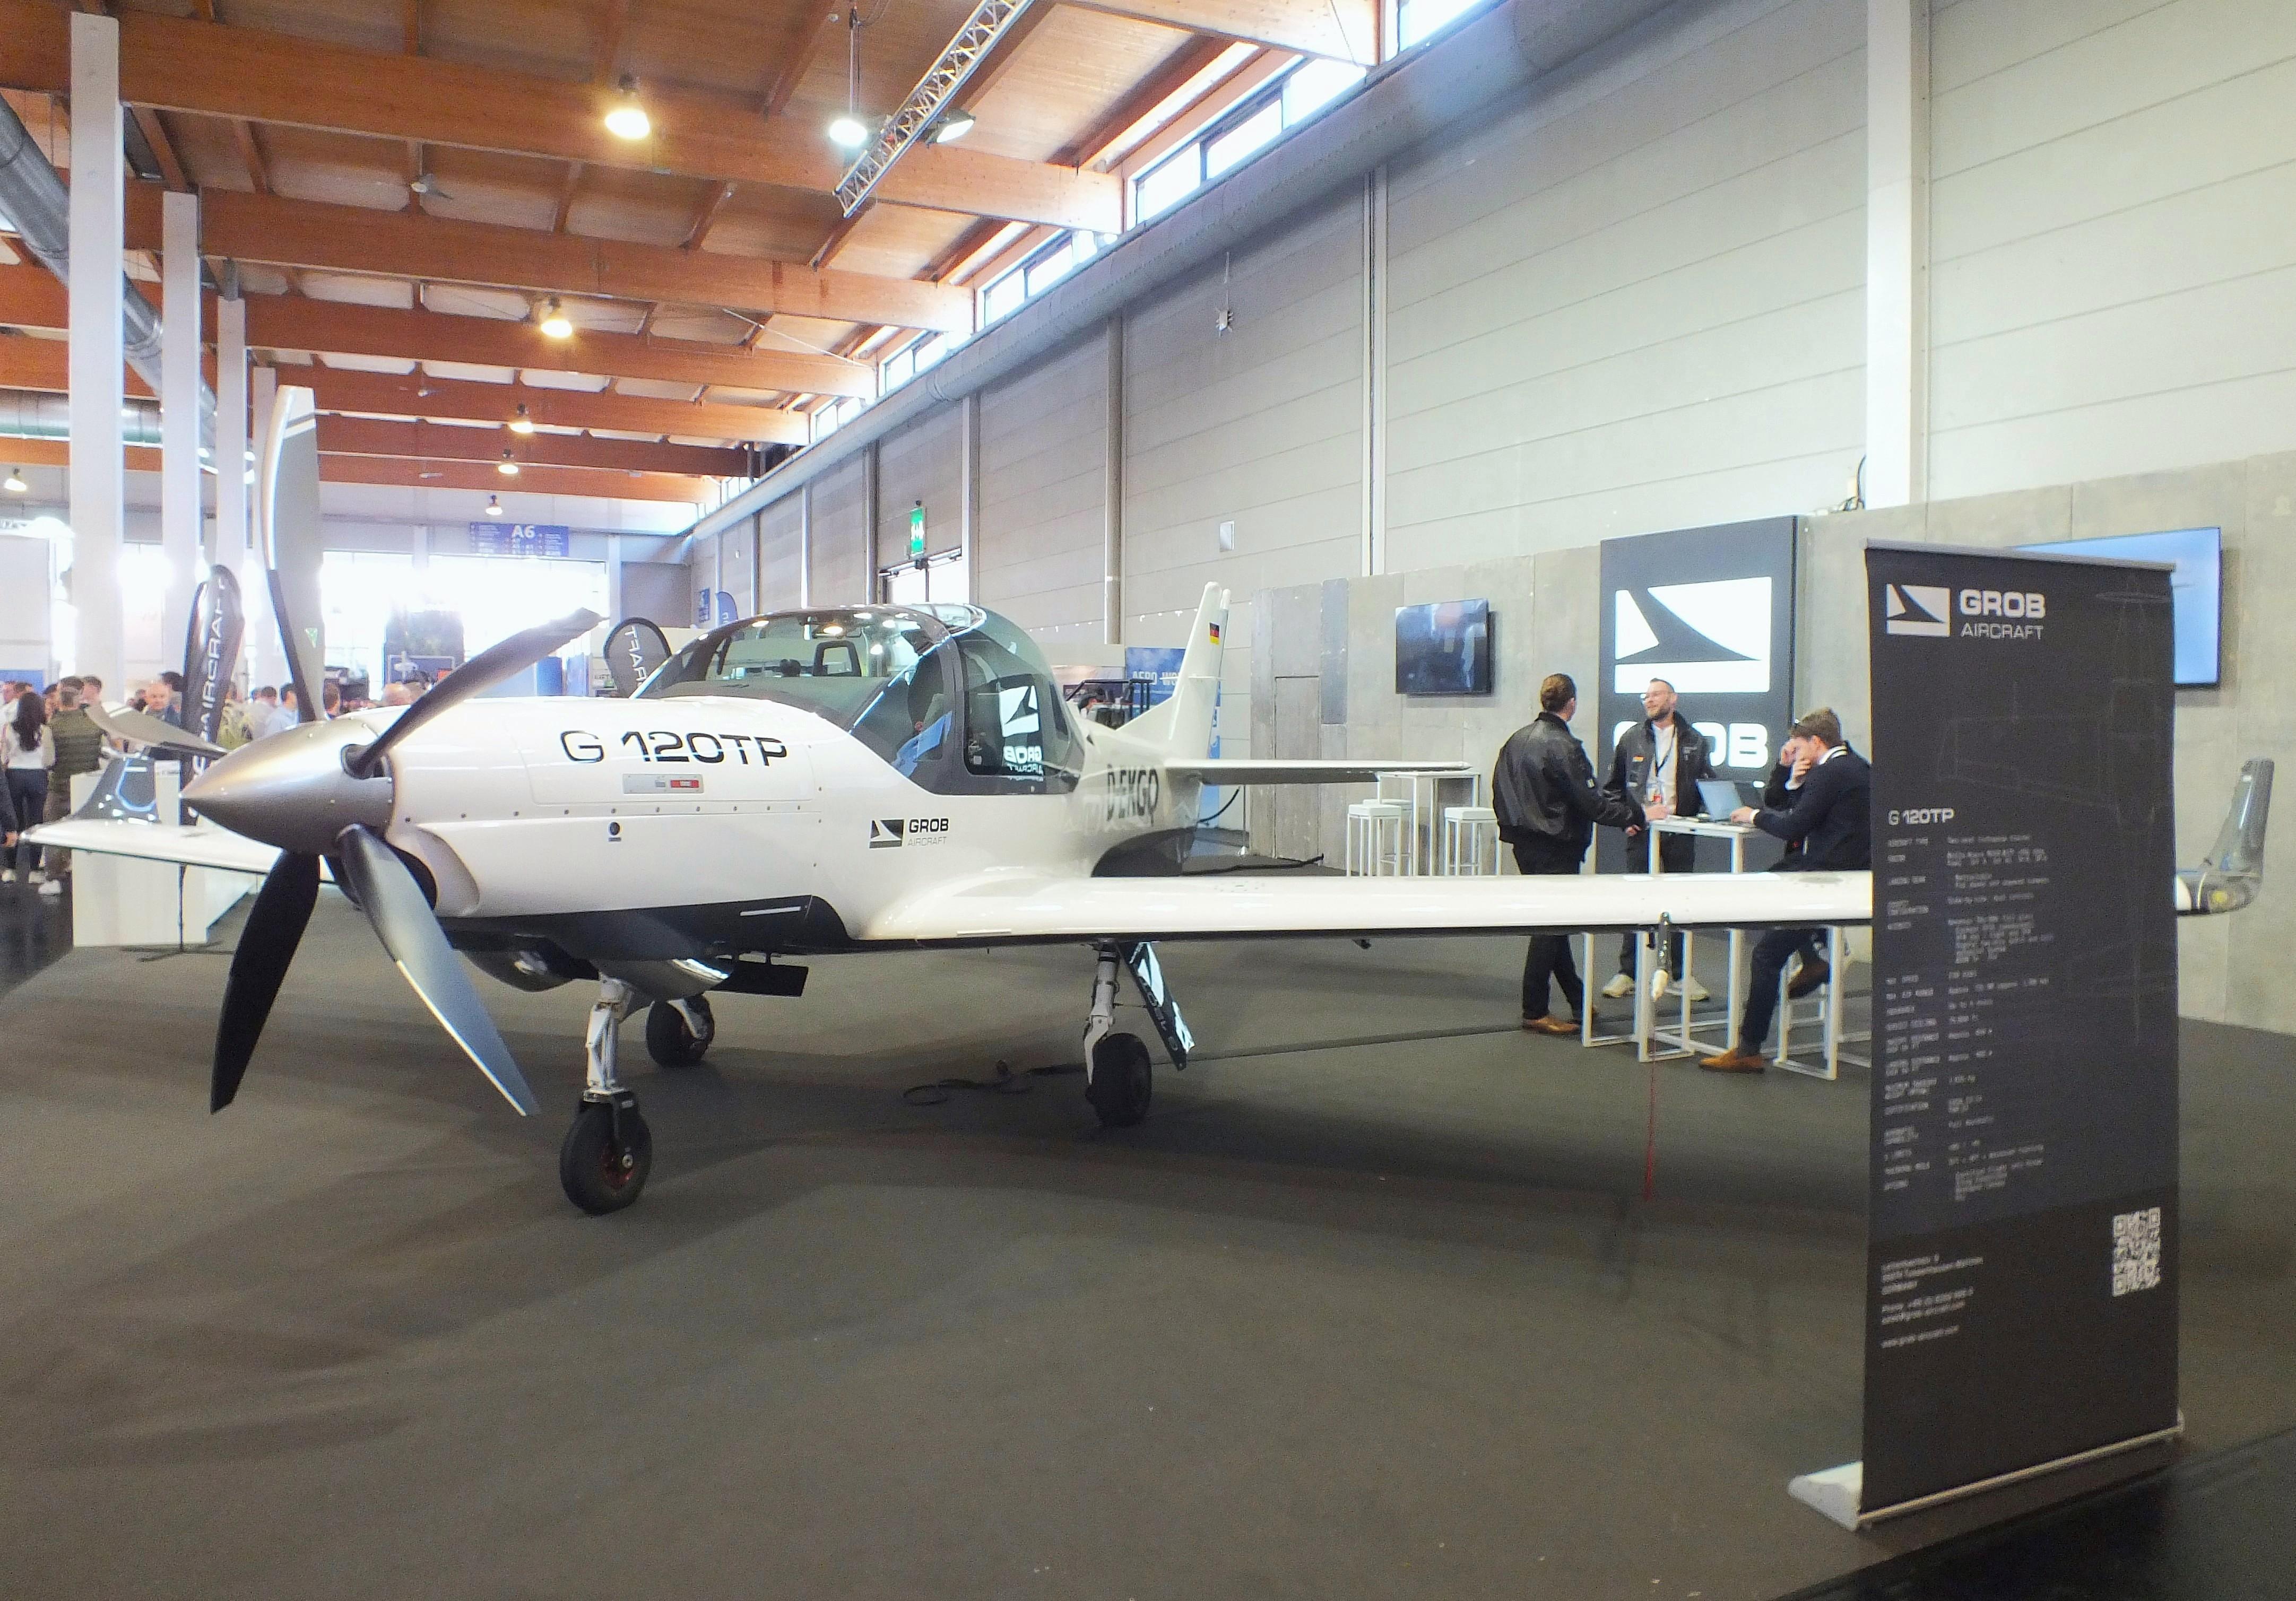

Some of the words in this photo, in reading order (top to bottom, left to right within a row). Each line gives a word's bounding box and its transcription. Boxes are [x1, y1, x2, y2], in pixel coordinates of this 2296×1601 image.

[512, 525, 535, 538] A6
[1960, 589, 2046, 619] GROB
[1961, 623, 2043, 640] AIRCRAFT
[560, 730, 605, 764] G
[621, 731, 787, 767] 120TP
[1888, 810, 1900, 825] G
[1902, 807, 1955, 824] 120TP
[909, 818, 949, 833] GROB
[907, 837, 947, 846] AIRCRAFT
